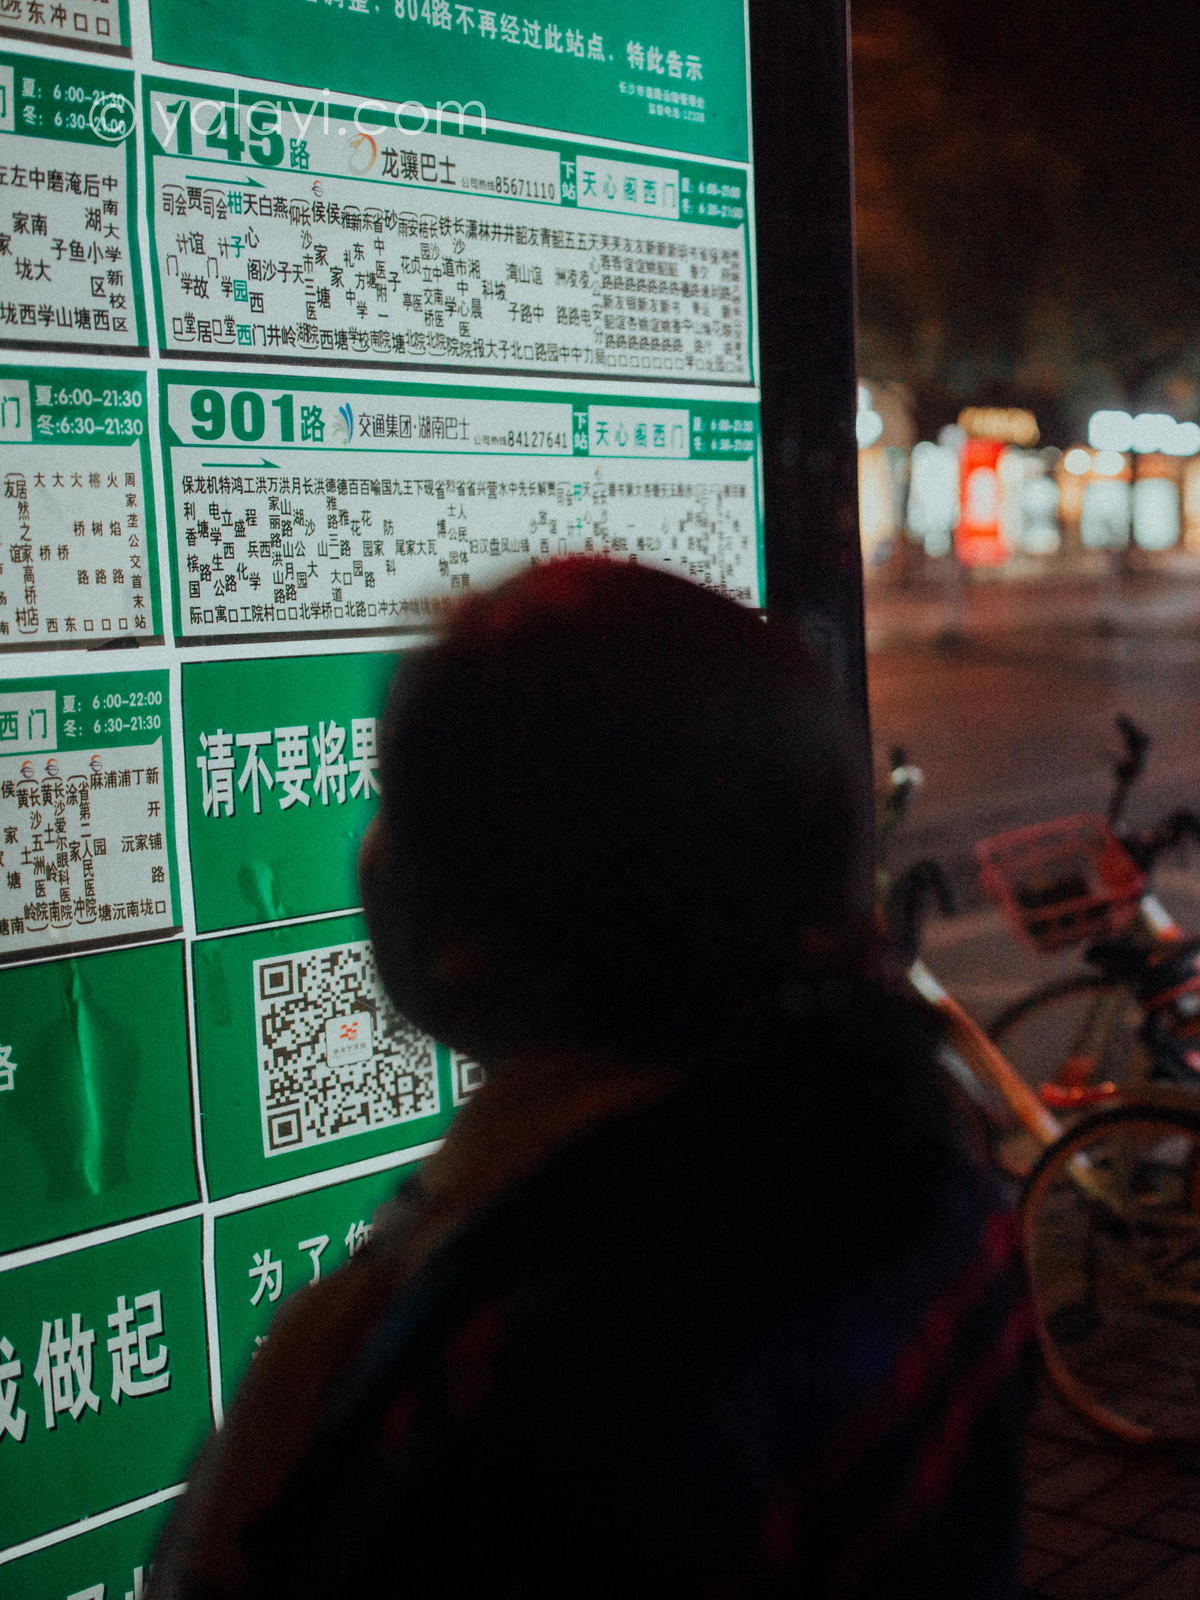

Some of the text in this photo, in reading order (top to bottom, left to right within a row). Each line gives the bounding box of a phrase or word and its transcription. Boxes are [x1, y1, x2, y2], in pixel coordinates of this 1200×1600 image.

[166, 99, 310, 171] 145路
[381, 147, 456, 186] 龙骧巴士
[29, 166, 55, 328] 中南大学
[83, 173, 110, 331] 后湖小区西
[102, 175, 129, 332] 中南大学新校区
[187, 186, 213, 344] 贾谊故居
[228, 190, 252, 346] 柑子园西
[243, 193, 267, 348] 天心阁西门
[259, 194, 281, 347] 白沙井
[273, 196, 297, 348] 燕子岭
[312, 201, 334, 350] 侯家塘西
[326, 202, 349, 351] 侯家塘
[35, 385, 142, 407] 夏:6:00-21:30
[37, 415, 144, 436] 冬:6:30-21:30
[190, 388, 325, 443] 901路
[182, 475, 202, 625] 保利香槟国际
[195, 475, 214, 624] 龙塘路口
[206, 475, 227, 623] 机电学生公寓
[218, 475, 238, 623] 特立西路口
[231, 476, 252, 622] 鸿盛化工
[244, 477, 264, 622] 工程兵学院
[255, 476, 275, 621] 洪西村
[267, 477, 286, 621] 万家丽路洪山路口
[291, 477, 311, 621] 月湖公园北
[302, 477, 322, 620] 长沙大学
[314, 478, 333, 620] 洪山桥
[62, 691, 162, 713] 夏: 6:00-22:00
[64, 715, 162, 737] 冬: 6:30-21:30
[52, 782, 74, 921] 长沙爱尔眼科医院
[78, 781, 97, 917] 省第二人民医院
[145, 767, 167, 915] 新开铺路口
